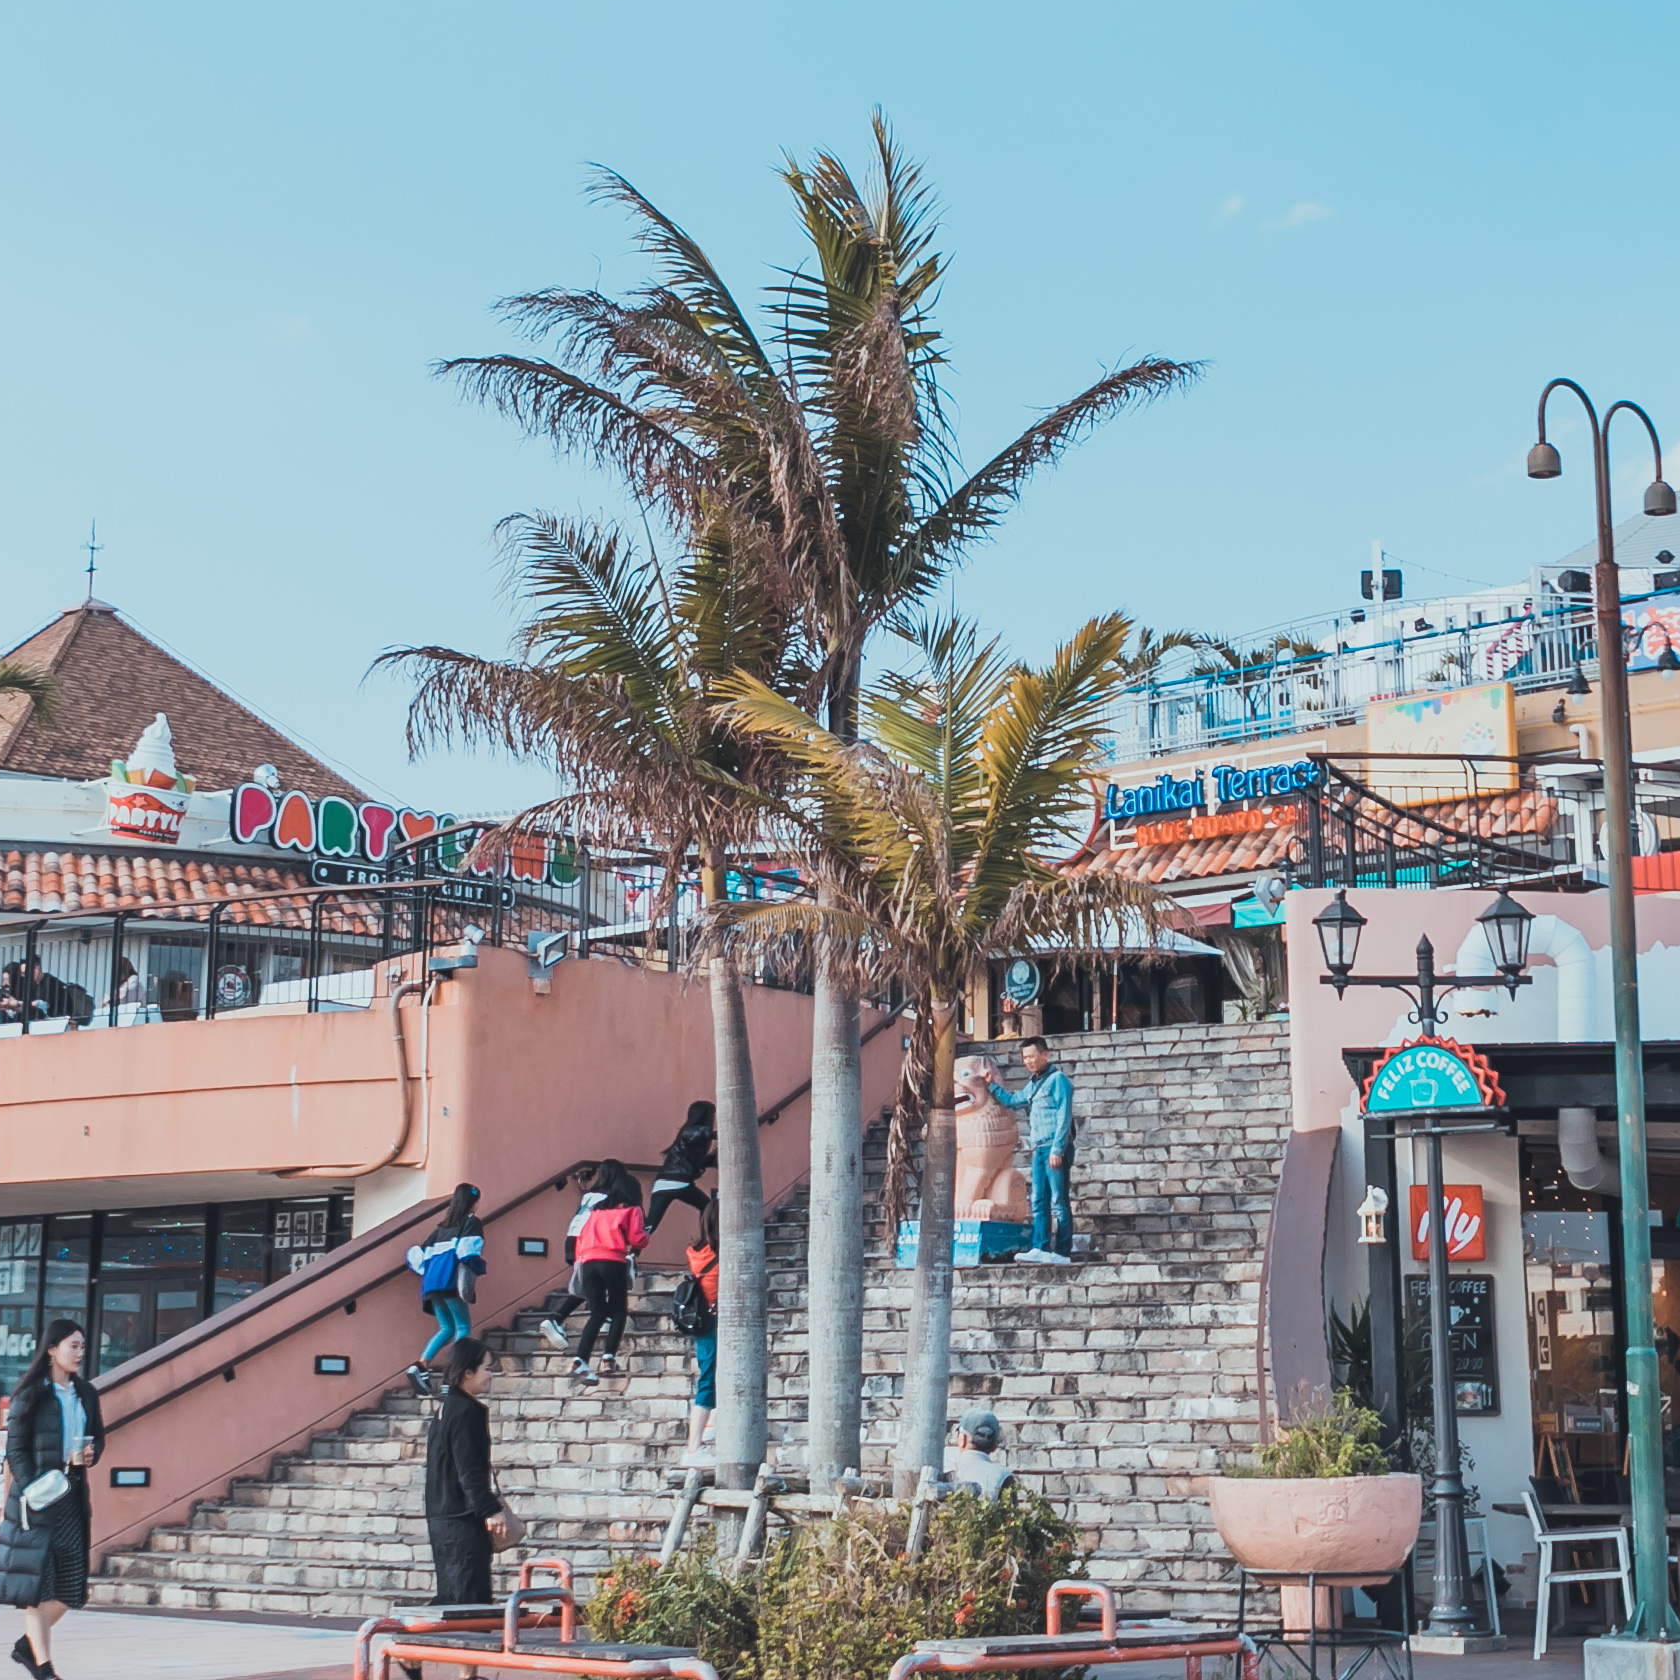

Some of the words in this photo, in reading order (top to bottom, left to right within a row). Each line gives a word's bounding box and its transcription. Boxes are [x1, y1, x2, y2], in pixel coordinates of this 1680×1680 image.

[1105, 769, 1206, 819] Lanikai
[1377, 1053, 1416, 1101] FELIZ
[1415, 1050, 1472, 1095] COFFEE
[1448, 1280, 1487, 1295] COFFEE
[1421, 1331, 1477, 1351] OEN
